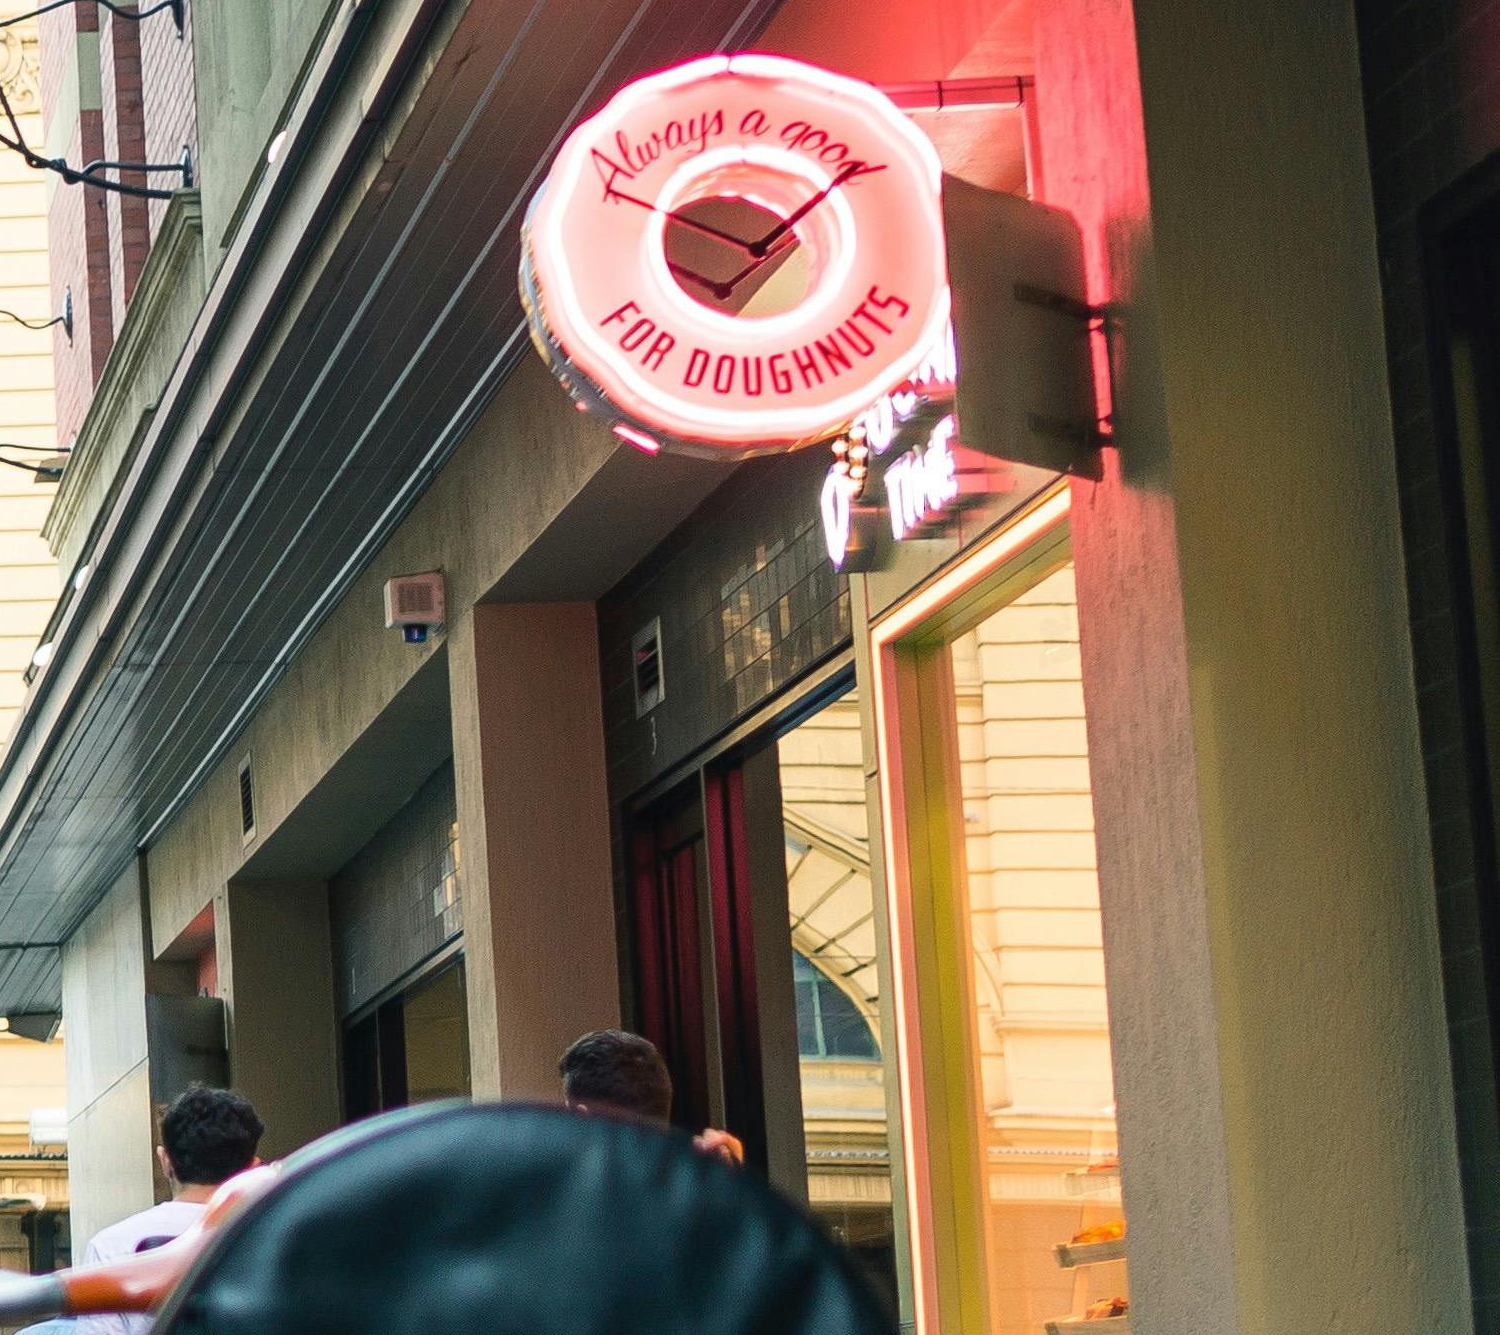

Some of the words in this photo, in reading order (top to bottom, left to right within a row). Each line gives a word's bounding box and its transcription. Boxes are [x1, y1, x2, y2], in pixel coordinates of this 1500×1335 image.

[590, 108, 726, 207] Always
[739, 109, 771, 135] a
[780, 119, 888, 189] good
[600, 300, 676, 372] FOR
[683, 284, 911, 397] DOUGHNUTS
